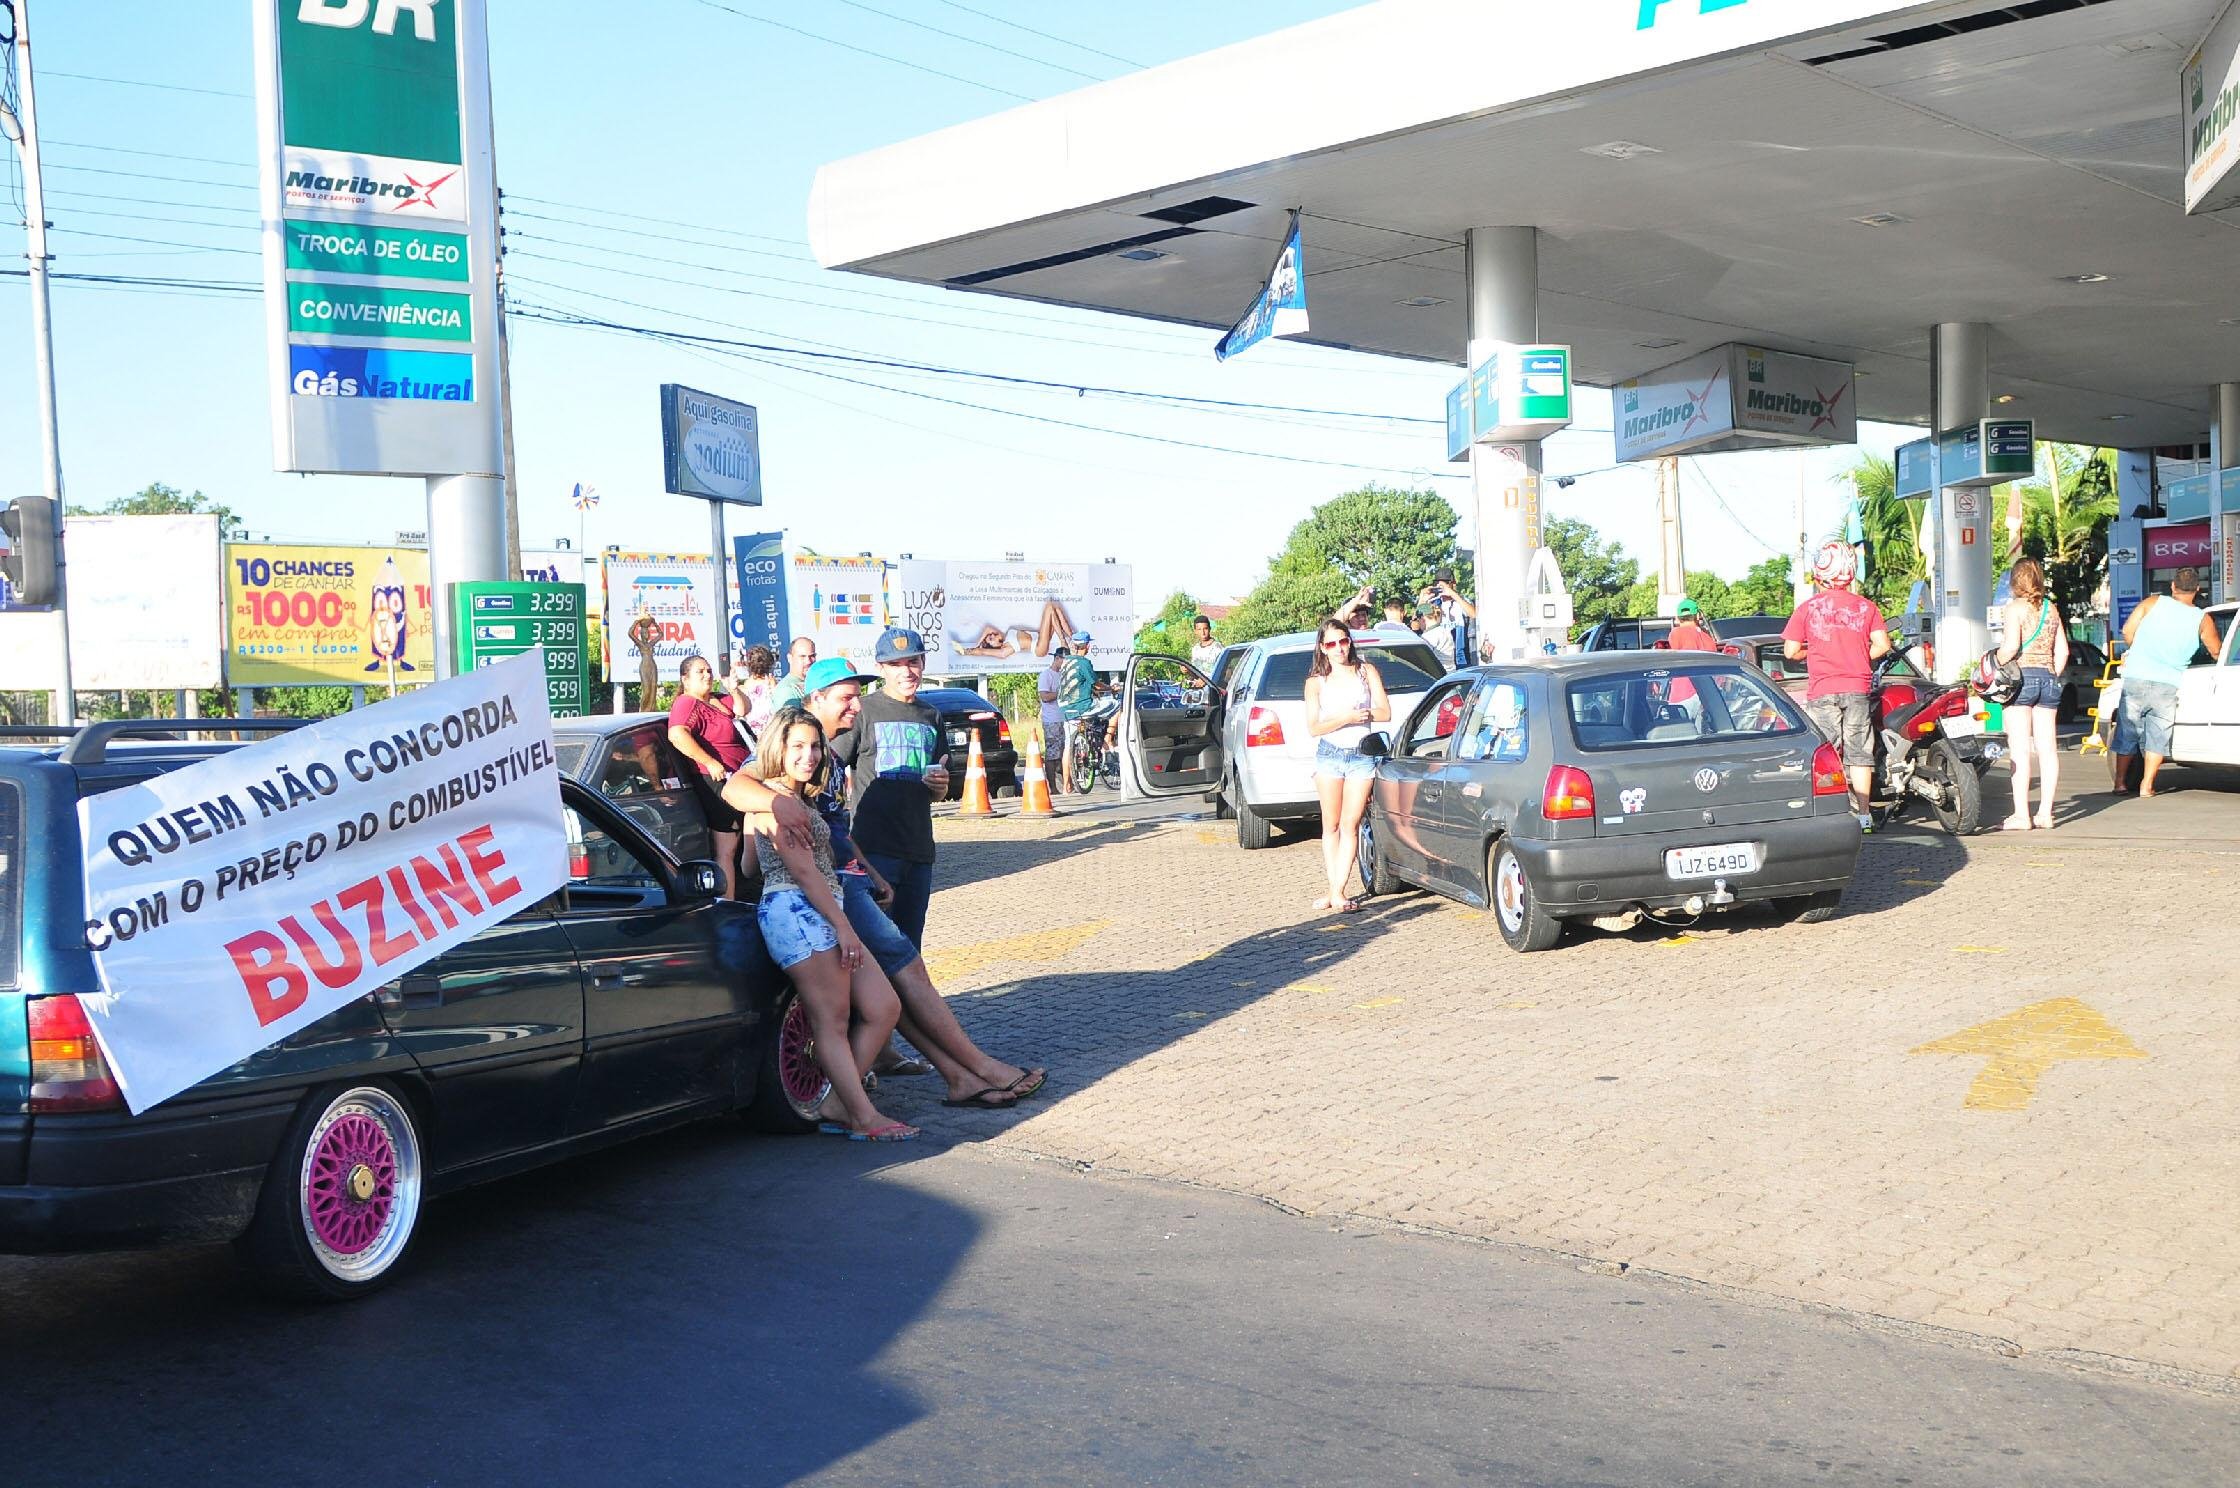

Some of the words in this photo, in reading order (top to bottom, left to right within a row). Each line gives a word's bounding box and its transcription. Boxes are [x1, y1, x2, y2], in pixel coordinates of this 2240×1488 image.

[286, 171, 415, 198] Maribro
[298, 233, 368, 256] TROCA
[374, 239, 401, 259] DE
[406, 238, 460, 264] ÓLEO
[300, 300, 462, 328] CONVENIÊNCIA
[684, 396, 708, 421] Aqui
[711, 406, 753, 431] gasolina
[2154, 542, 2189, 556] BR
[236, 558, 270, 587] 10
[273, 560, 355, 577] CHANCES
[744, 560, 776, 574] eco
[273, 577, 294, 589] DE
[296, 577, 356, 590] GANHAR
[746, 575, 777, 586] frotas
[531, 593, 574, 612] 3,299
[239, 627, 269, 640] em
[274, 629, 358, 646] compras
[531, 622, 575, 642] 3,399
[313, 645, 358, 654] CUPOM
[652, 643, 703, 657] studante
[548, 652, 576, 670] 999
[549, 681, 578, 699] 599
[107, 794, 246, 867] QUEM
[246, 763, 339, 818] NÃO
[344, 694, 518, 782] CONCORDA
[84, 892, 169, 953] COM
[180, 879, 205, 914] O
[215, 831, 328, 900] PREÇO
[335, 811, 379, 853] DO
[388, 739, 555, 832] COMBUSTÍVEL
[223, 824, 523, 1029] BUZINE
